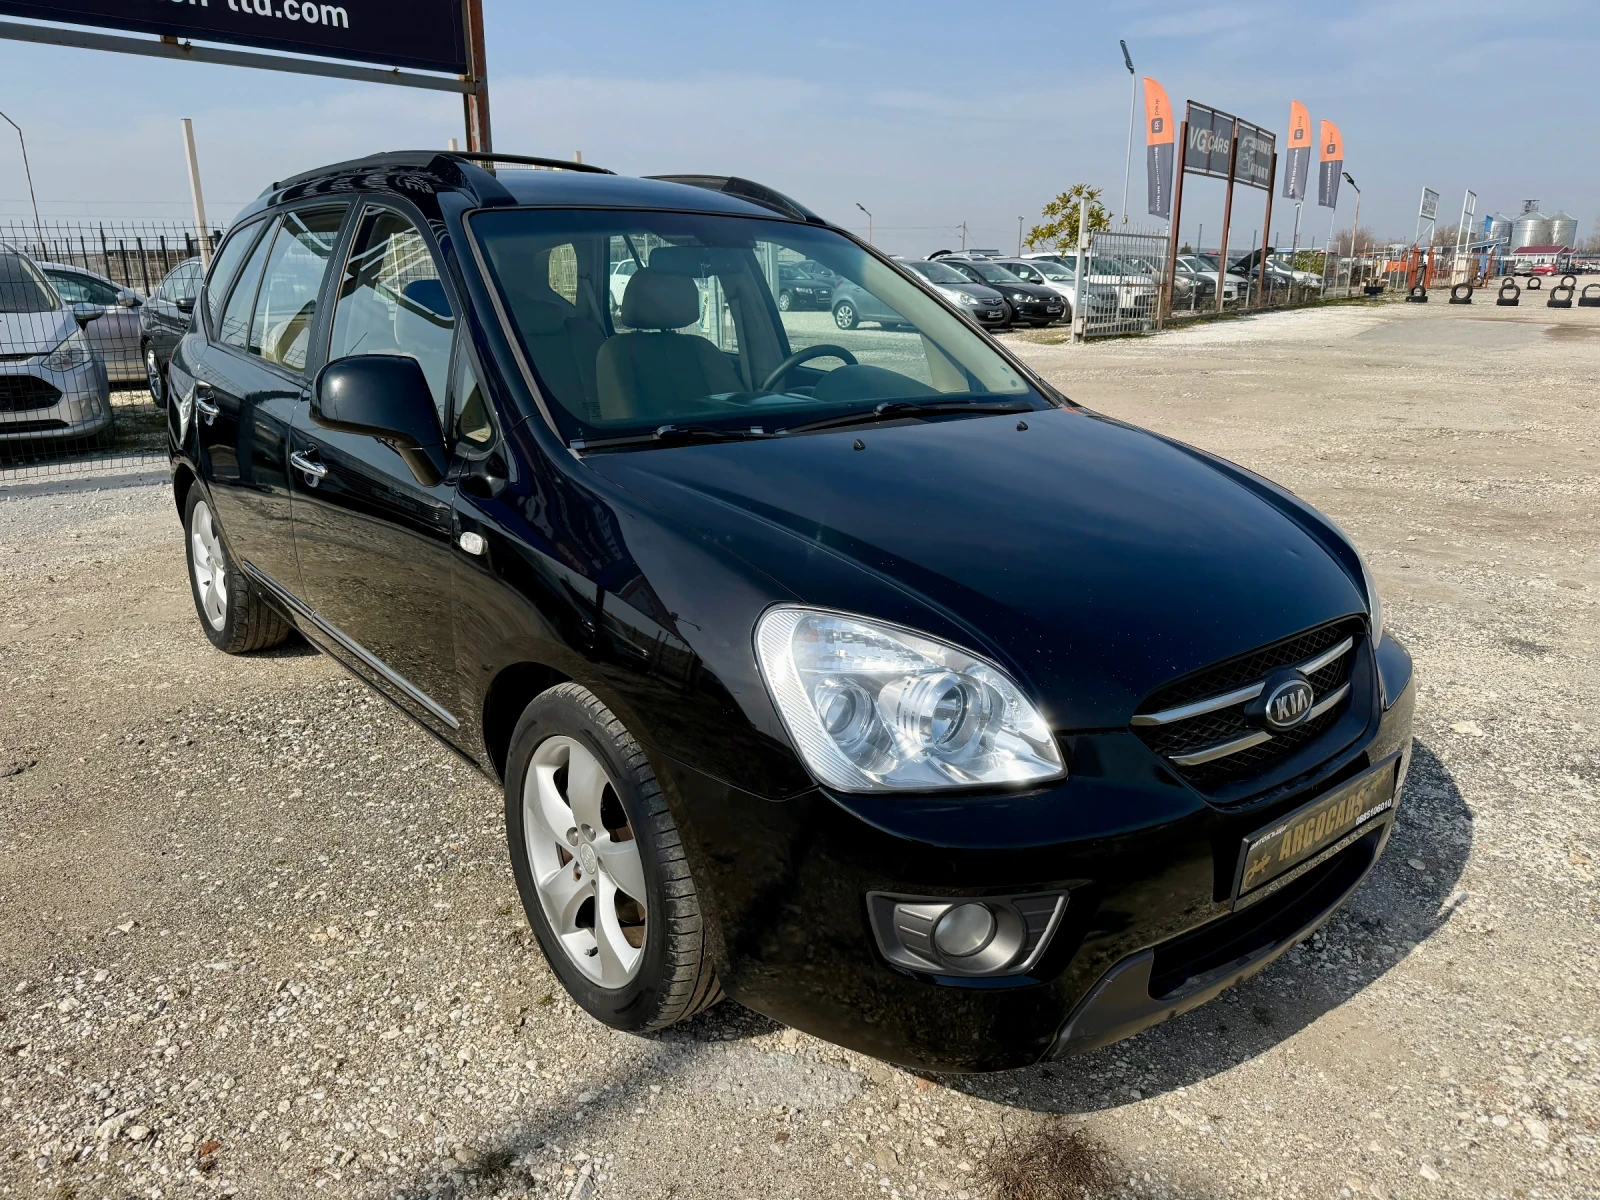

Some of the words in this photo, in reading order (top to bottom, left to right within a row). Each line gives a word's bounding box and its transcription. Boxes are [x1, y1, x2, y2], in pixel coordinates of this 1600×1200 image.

[1208, 134, 1230, 155] CARS
[1275, 688, 1309, 721] KIA
[1278, 788, 1366, 862] ARGOCARS
